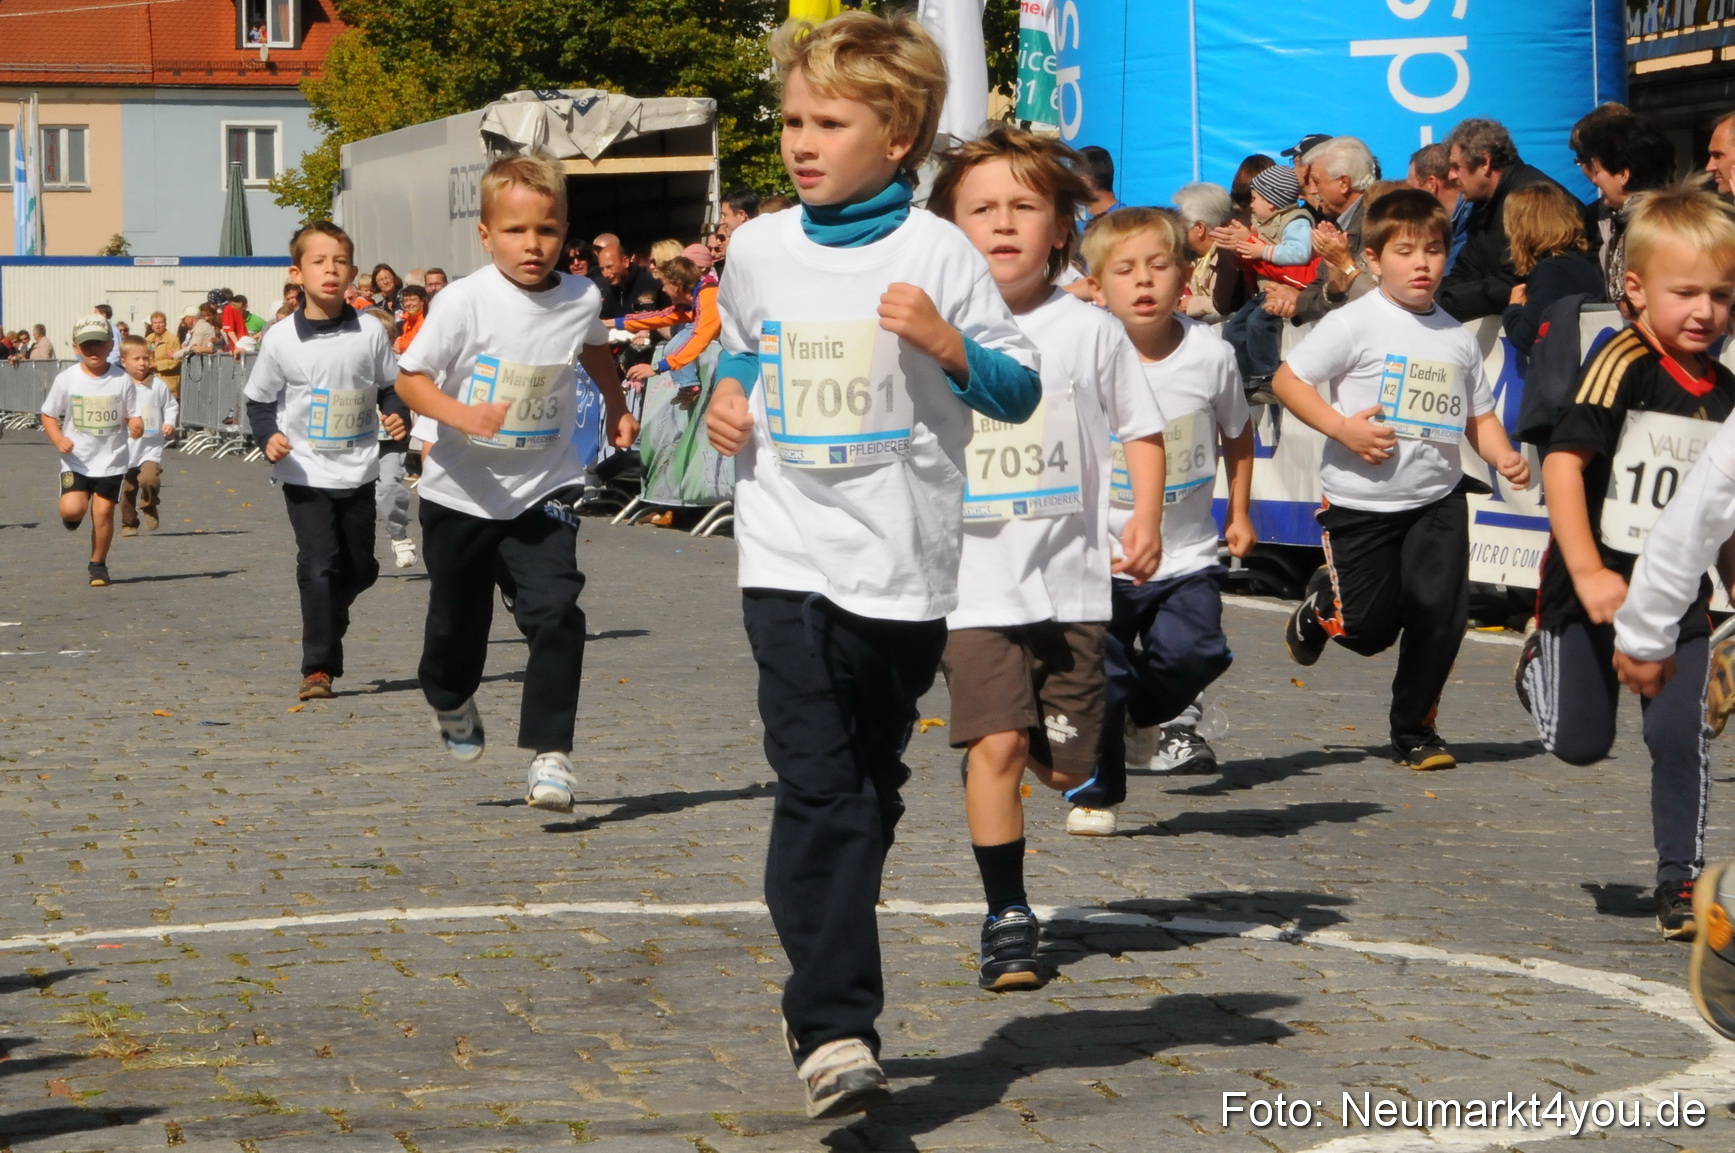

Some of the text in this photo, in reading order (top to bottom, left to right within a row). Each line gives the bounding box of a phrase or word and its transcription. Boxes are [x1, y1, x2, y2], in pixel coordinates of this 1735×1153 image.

[787, 332, 844, 360] Yanic
[502, 368, 546, 388] Marius
[1409, 363, 1447, 384] Cedrik
[472, 386, 487, 401] K2
[765, 374, 778, 395] K2
[1383, 383, 1397, 396] K2
[791, 374, 894, 417] 7061
[1408, 388, 1461, 417] 7068
[86, 409, 118, 422] 7300
[975, 440, 1069, 480] 7034
